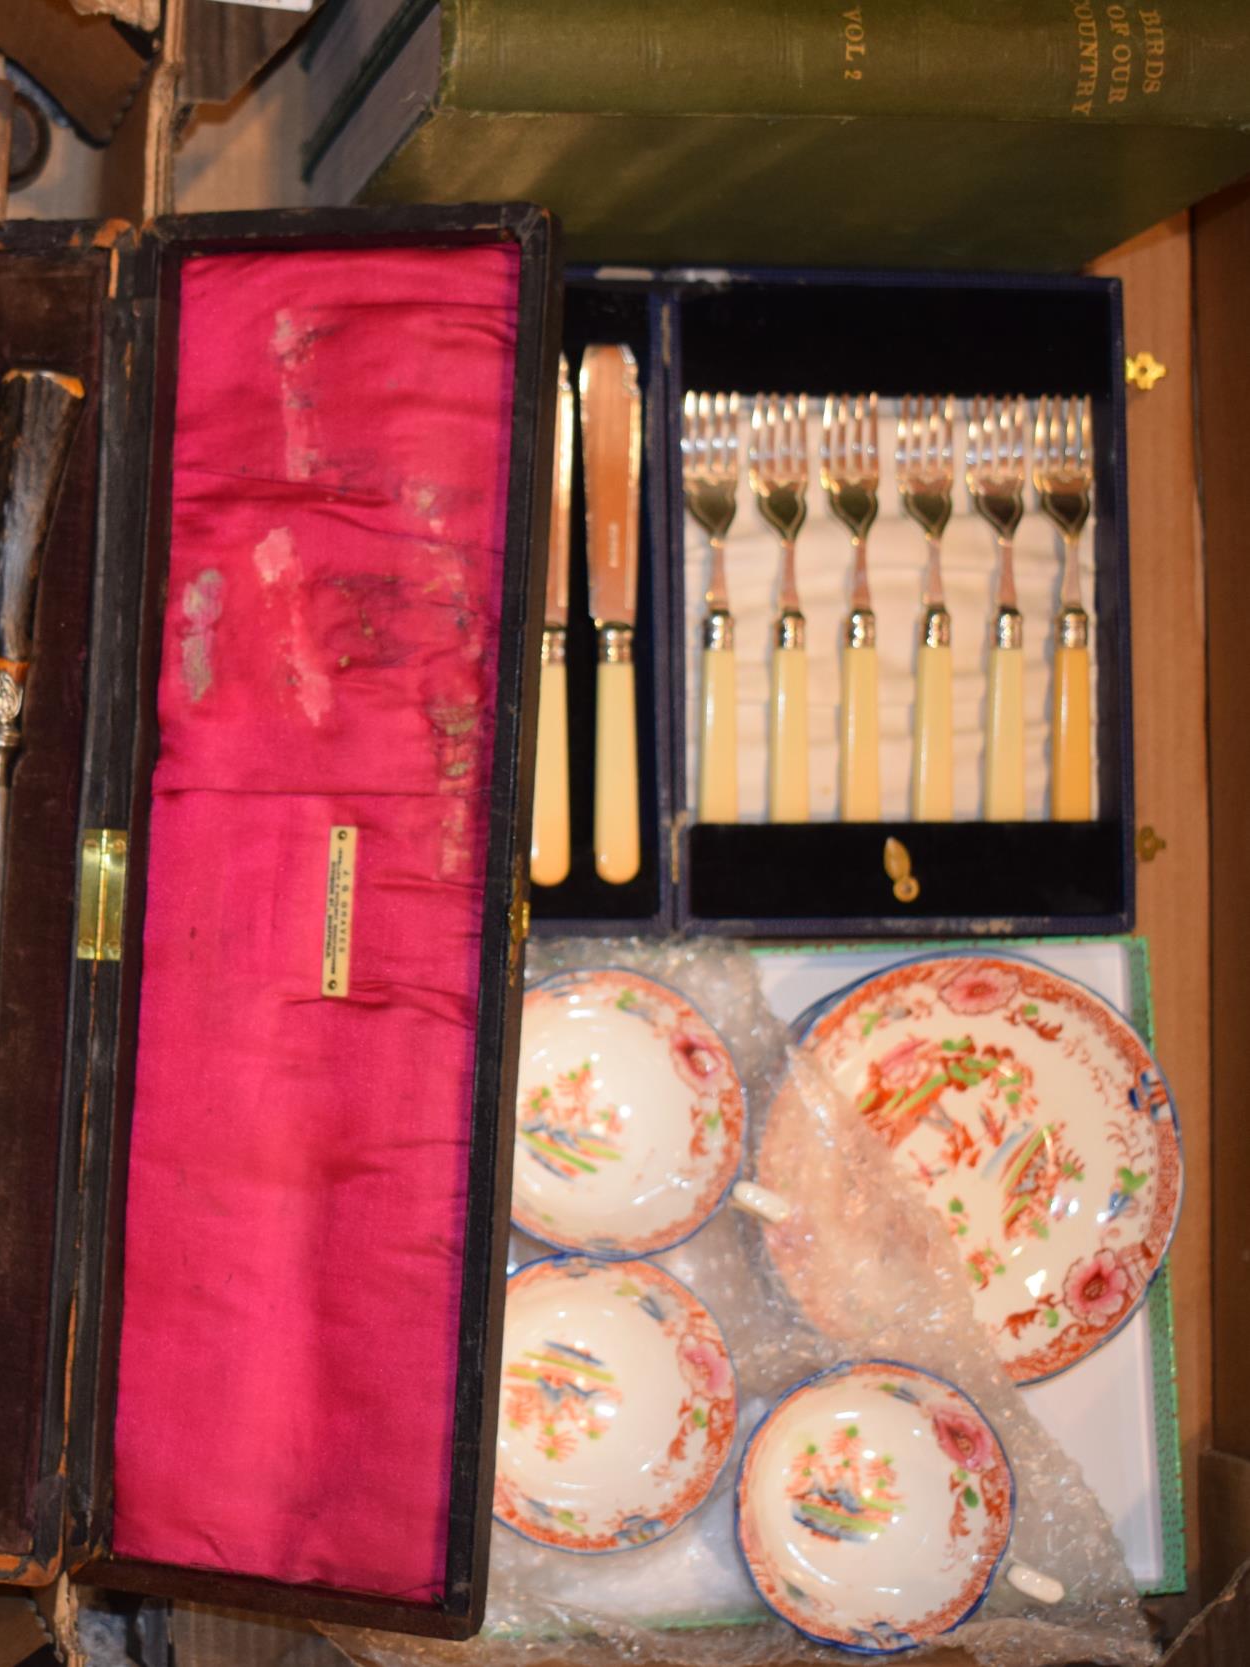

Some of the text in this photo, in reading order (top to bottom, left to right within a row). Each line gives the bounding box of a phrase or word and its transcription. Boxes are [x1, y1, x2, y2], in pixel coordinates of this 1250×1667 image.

[843, 5, 866, 80] VOL 2
[1071, 0, 1098, 116] OUNTRY
[1107, 4, 1132, 104] OF OUR
[1138, 9, 1165, 94] BIRDS
